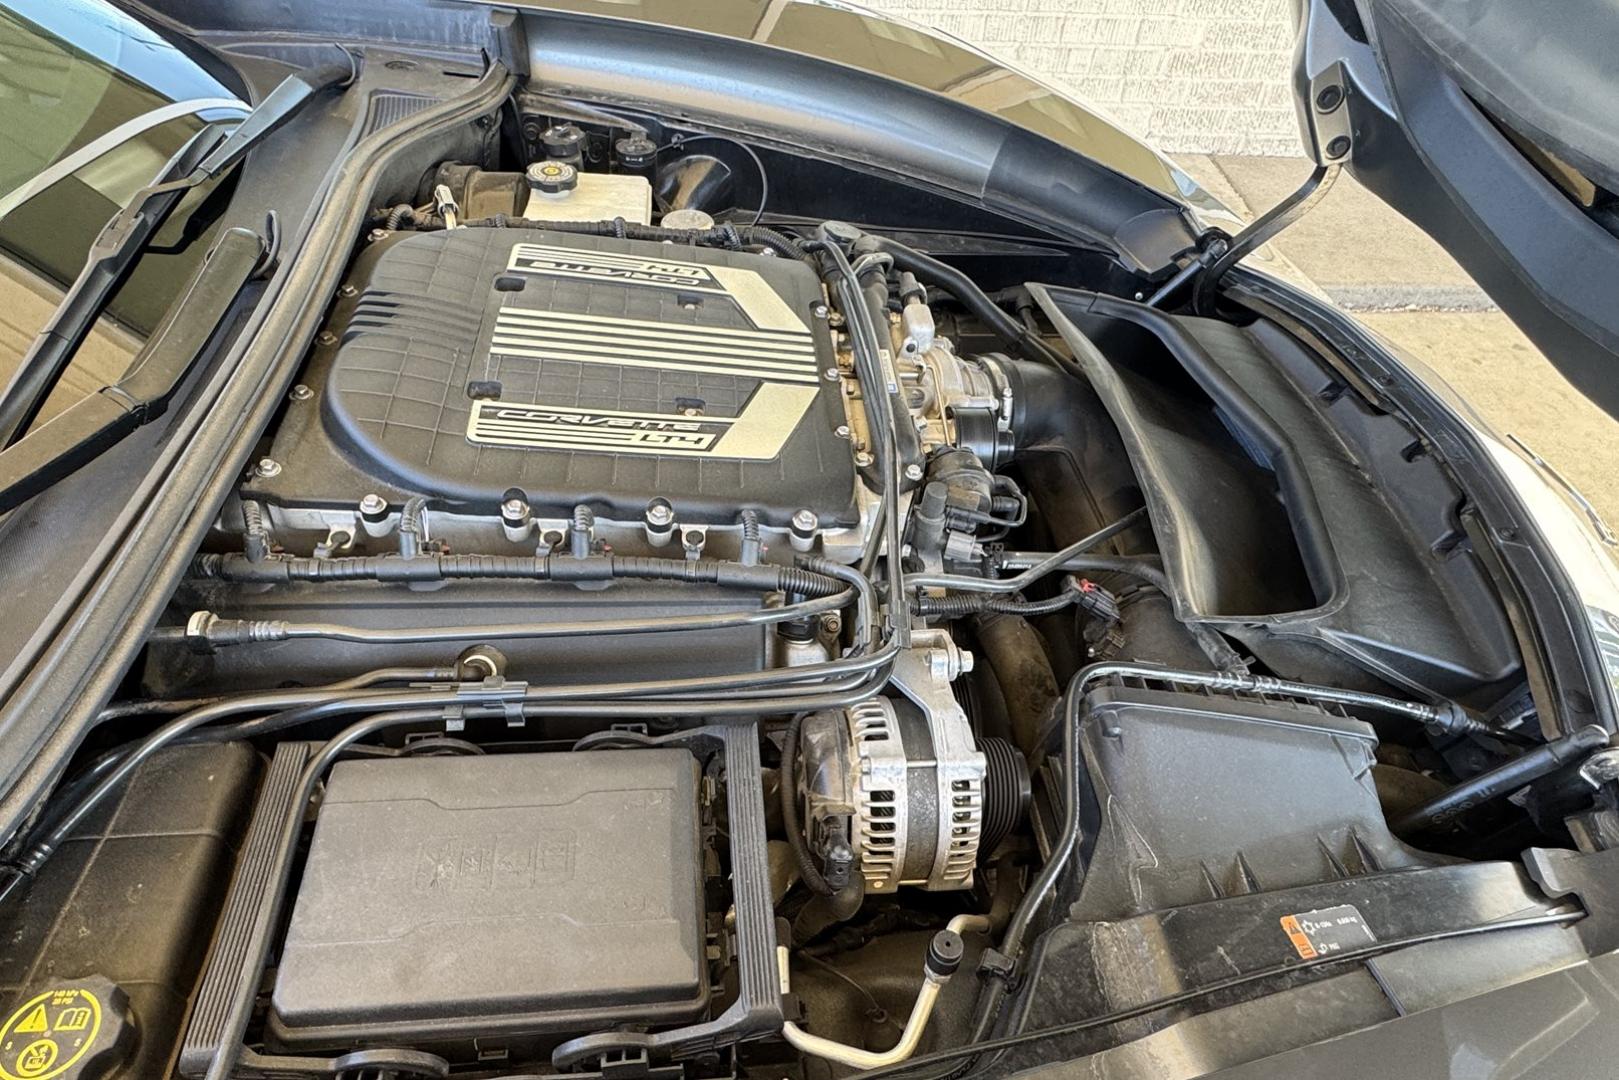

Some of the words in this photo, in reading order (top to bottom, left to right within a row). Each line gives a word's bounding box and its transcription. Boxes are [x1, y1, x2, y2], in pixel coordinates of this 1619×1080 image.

[529, 260, 700, 286] CORVETTE
[496, 408, 701, 432] CORVETTE
[639, 433, 704, 445] LT4
